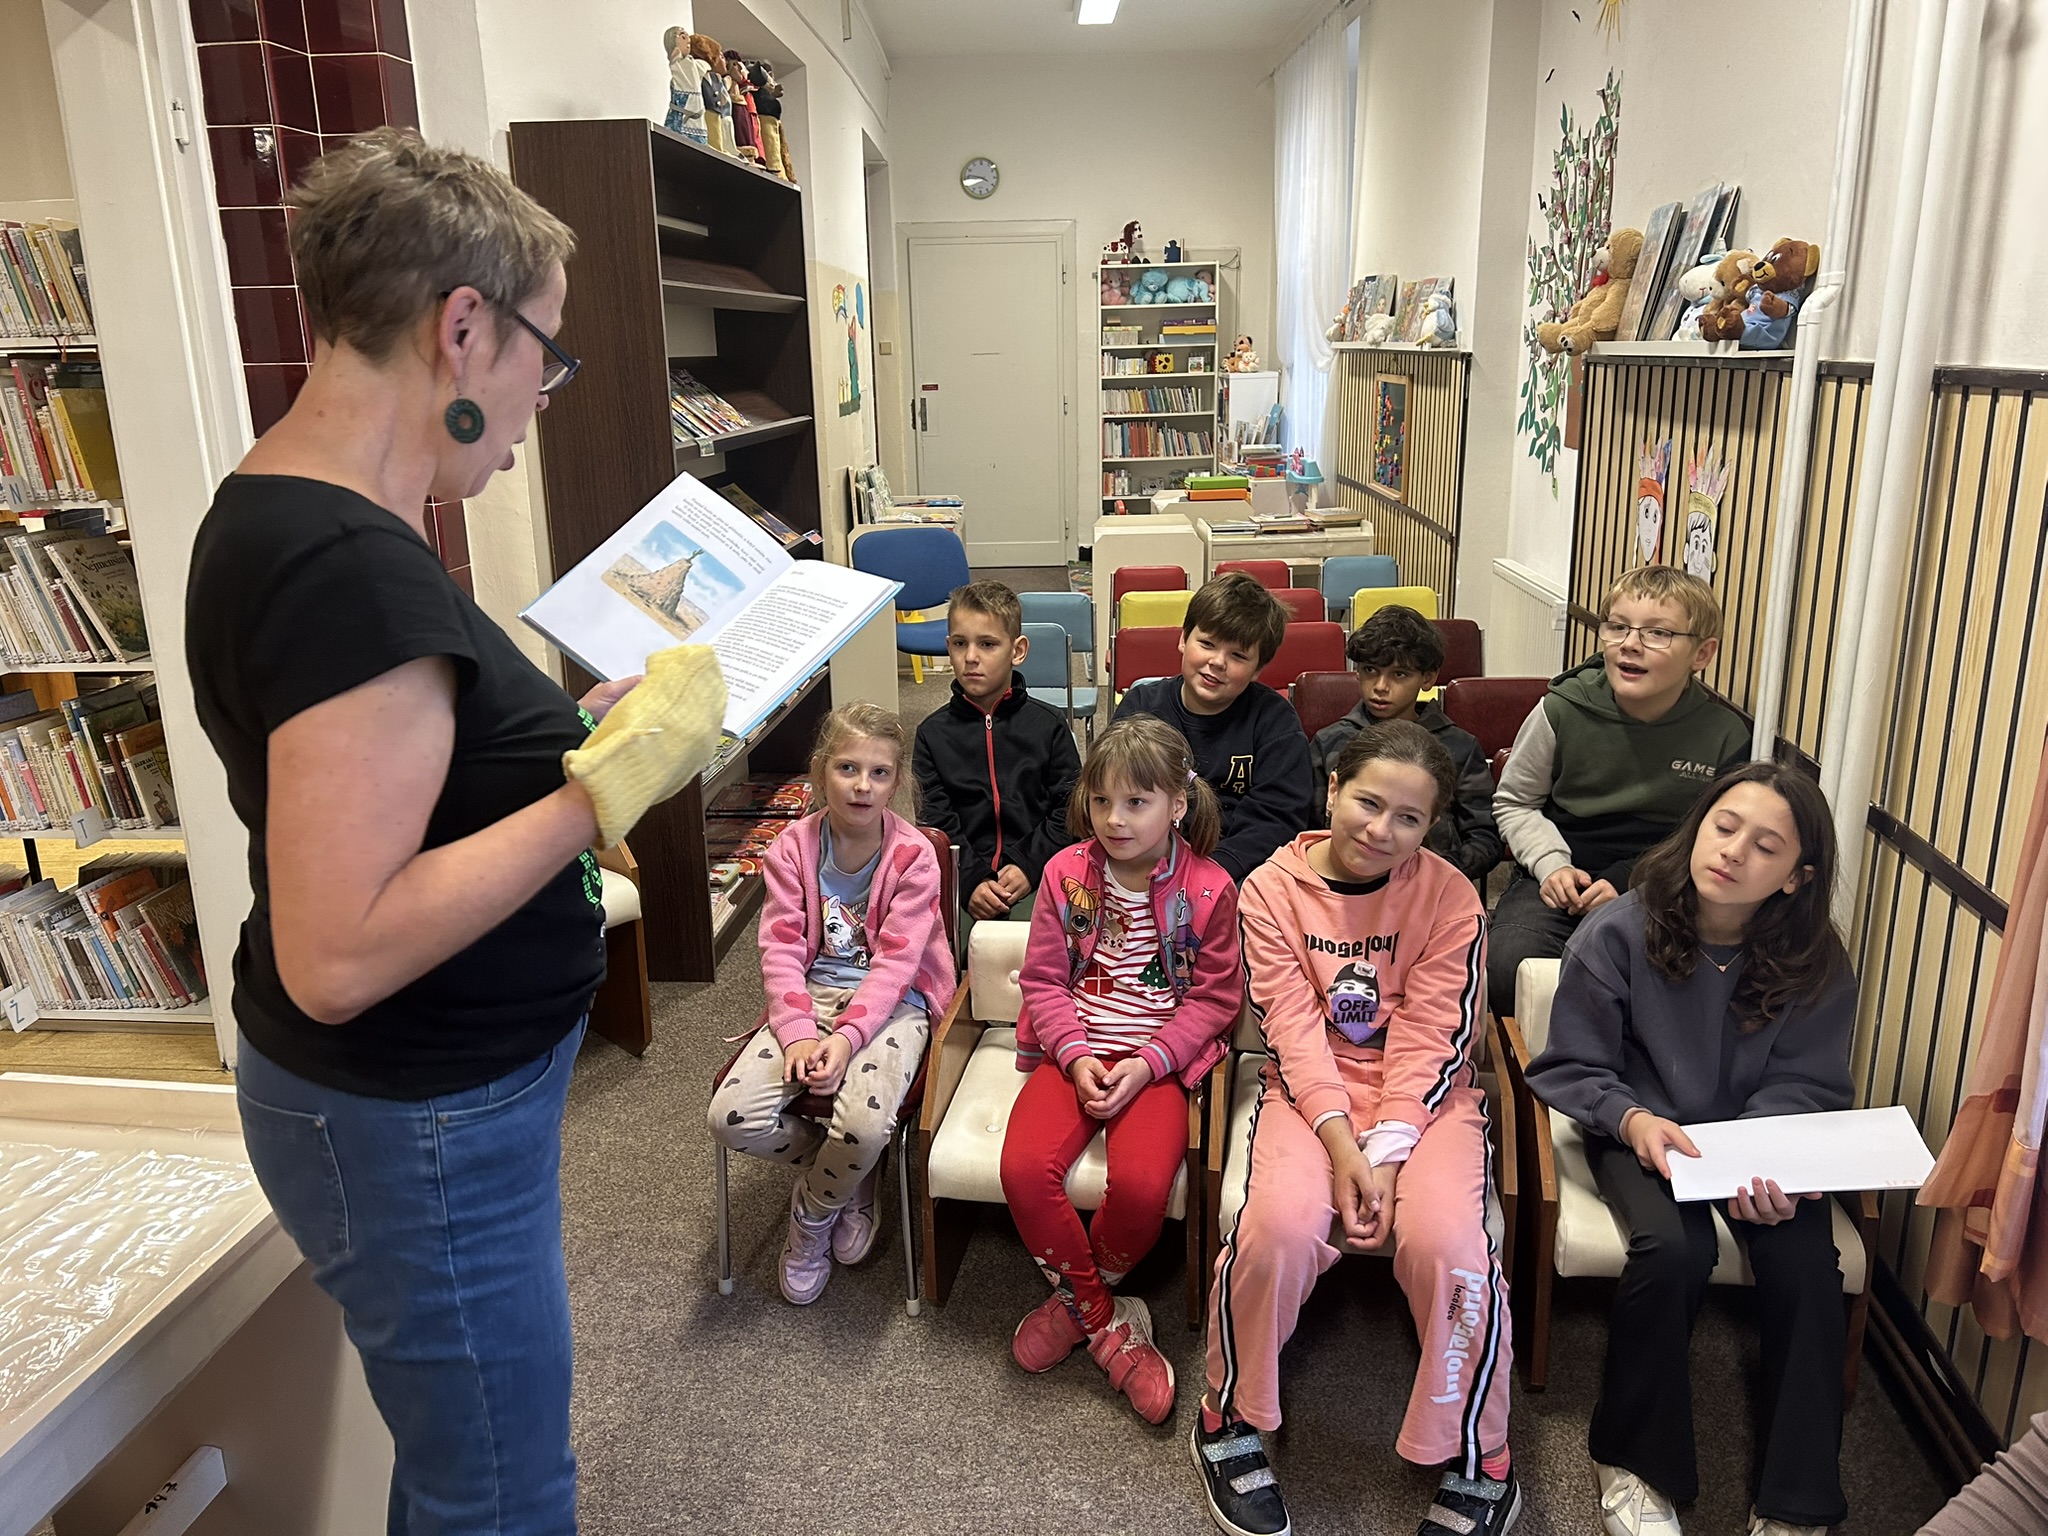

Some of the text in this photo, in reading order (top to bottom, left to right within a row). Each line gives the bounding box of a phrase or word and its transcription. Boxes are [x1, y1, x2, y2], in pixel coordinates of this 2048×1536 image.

[9, 483, 22, 505] N
[1220, 755, 1254, 794] A
[1671, 760, 1716, 777] GAME
[77, 818, 88, 839] T
[63, 902, 82, 919] ŽÁČE
[1338, 998, 1370, 1012] OFF
[1333, 1010, 1376, 1025] LIMIT
[1447, 1284, 1466, 1321] locoloco
